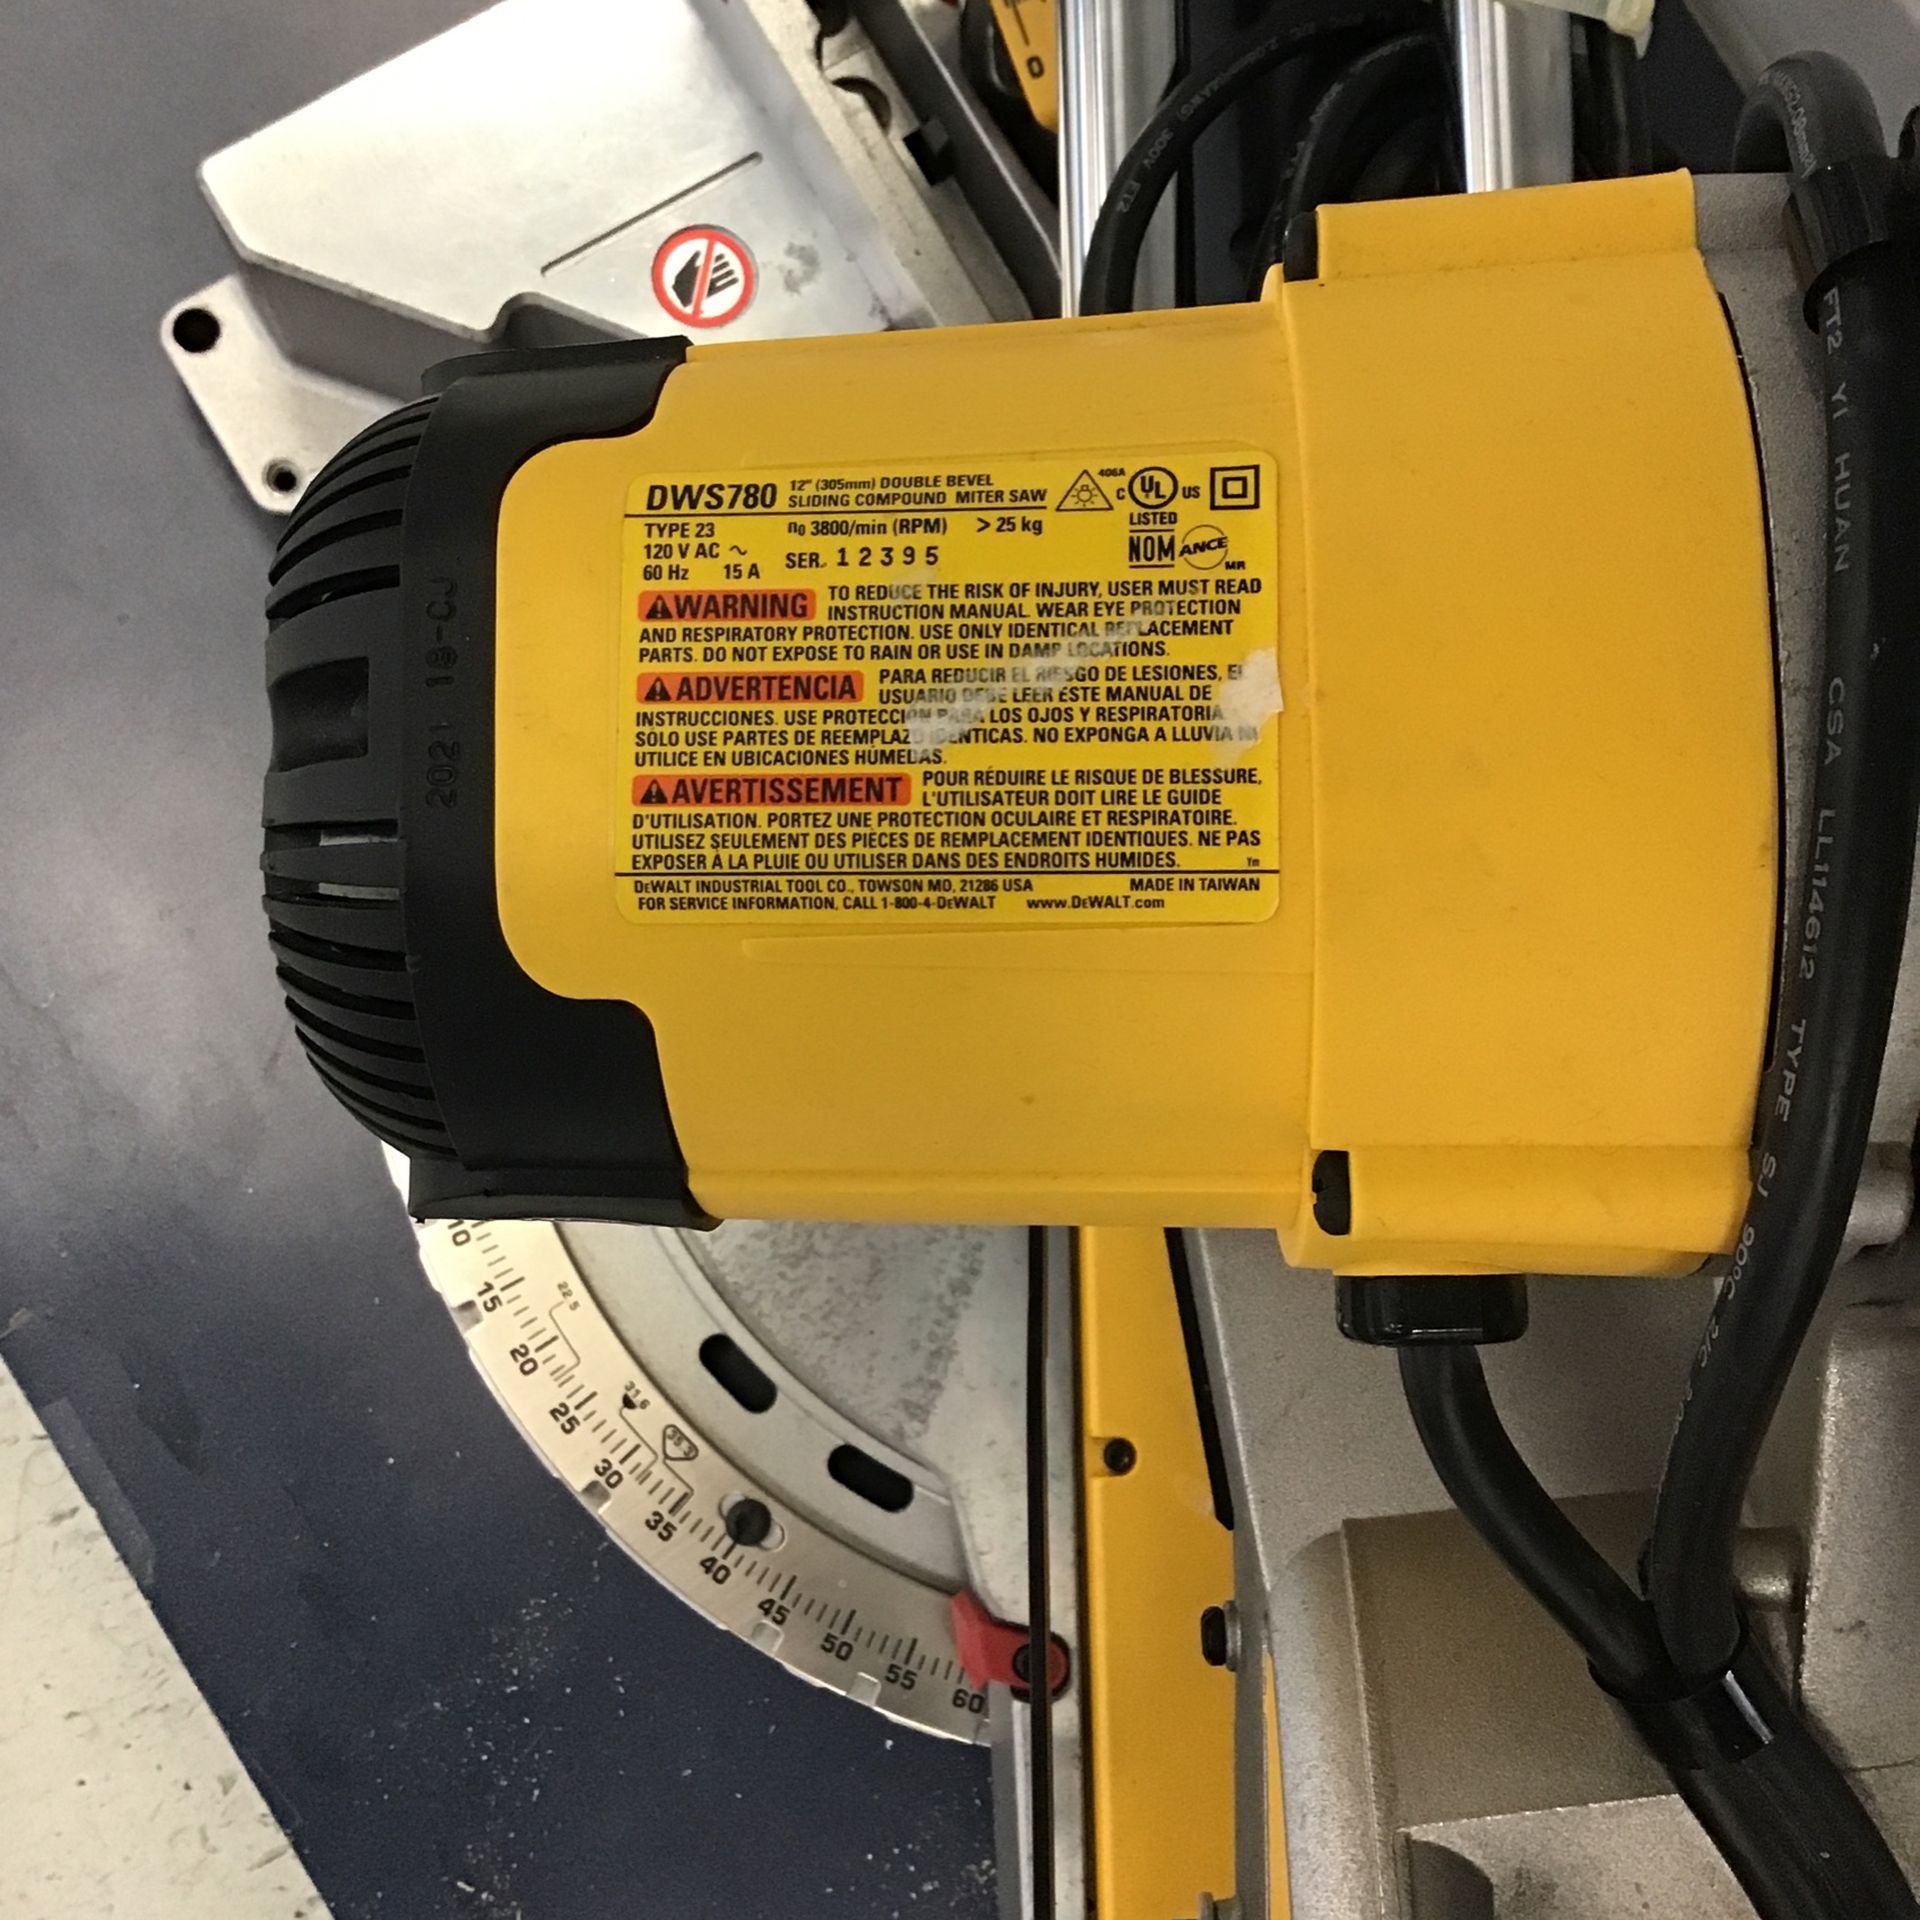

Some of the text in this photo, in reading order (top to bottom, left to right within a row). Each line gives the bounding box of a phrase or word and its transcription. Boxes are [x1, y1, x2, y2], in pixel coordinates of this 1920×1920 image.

[815, 474, 994, 491] (305mm) DOUBLE BEVEL
[646, 482, 777, 510] DWS780
[788, 489, 1047, 508] SLIDING COMPOUND MITER SAW
[1116, 487, 1200, 501] C US
[1128, 512, 1177, 526] LISTED
[1834, 451, 1851, 573] HUAN
[644, 522, 714, 538] TYPE 23
[892, 518, 947, 536] (RPM)
[995, 516, 1043, 534] 25 kg
[644, 542, 720, 560] 120 V AC
[1128, 534, 1175, 562] NOM
[642, 563, 689, 580] 60 Hz
[723, 562, 760, 580] 15 A
[828, 580, 1262, 601] TO REDUCE THE RISK OF INJURY, USER MUST READ
[674, 592, 807, 620] WARNING
[828, 603, 944, 620] INSTRUCTION
[1035, 601, 1088, 617] WEAR
[1093, 600, 1124, 617] EYE
[1130, 598, 1240, 616] PROTECTION
[638, 628, 676, 643] AND
[682, 626, 798, 642] RESPIRATORY
[920, 624, 953, 639] USE
[958, 623, 1003, 639] ONLY
[1008, 621, 1099, 638] IDENTICAL
[702, 647, 726, 662] DO
[732, 646, 767, 661] NOT
[772, 645, 837, 661] EXPOSE
[842, 645, 864, 660] TO
[870, 644, 912, 660] RAIN
[917, 644, 940, 659] OR
[946, 643, 979, 659] USE
[984, 643, 1003, 659] IN
[1009, 642, 1061, 658] DAMP
[879, 665, 1223, 684] PARA REDUCIR DE LESIONES,
[676, 675, 856, 701] ADVERTENCIA
[1012, 684, 1212, 703] LEER MANUAL DE
[636, 708, 1090, 727] INSTRUCCIONES. USE LOS OJOS Y
[1824, 676, 1847, 766] CSA
[684, 726, 1233, 747] USE PARTES DE NO EXPONGA A LLUVIA
[634, 750, 849, 767] UTILICE EN UBICACIONES
[922, 766, 1262, 786] POUR RÉDUIRE LE RISQUE DE BLESSURE,
[672, 777, 902, 804] AVERTISSEMENT
[922, 788, 1221, 807] L'UTILISATEUR DOIT LIRE LE GUIDE
[632, 810, 1237, 829] D'UTILISATION. PORTEZ UNE PROTECTION OCULAIRE ET RESPIRATOIRE.
[632, 834, 705, 850] UTILISEZ
[710, 833, 809, 849] SEULEMENT
[814, 833, 846, 849] DES
[914, 832, 934, 848] DE
[940, 831, 1081, 848] REMPLACEMENT
[1086, 830, 1192, 847] IDENTIQUES.
[1197, 830, 1220, 847] NE
[1226, 830, 1261, 846] PAS
[631, 851, 1180, 870] EXPOSER LA PLUIE OU UTILISER DANS DES ENDROITS HUMIDES.
[696, 880, 782, 893] INDUSTRIAL
[785, 880, 822, 893] TOOL
[857, 879, 923, 893] TOWSON
[959, 879, 998, 892] 21286
[1002, 879, 1033, 892] USA
[1129, 878, 1260, 892] MADE IN TAIWAN
[638, 897, 877, 911] FOR SERVICE INFORMATION, CALL
[1775, 1019, 1807, 1122] TYPE
[477, 1281, 503, 1313] 15
[510, 1343, 539, 1376] 20
[550, 1402, 581, 1435] 25
[594, 1458, 624, 1489] 30
[645, 1510, 678, 1542] 35
[699, 1555, 731, 1586] 40
[757, 1598, 791, 1627] 45
[820, 1634, 854, 1661] 50
[885, 1665, 918, 1691] 55
[952, 1689, 985, 1714] 60
